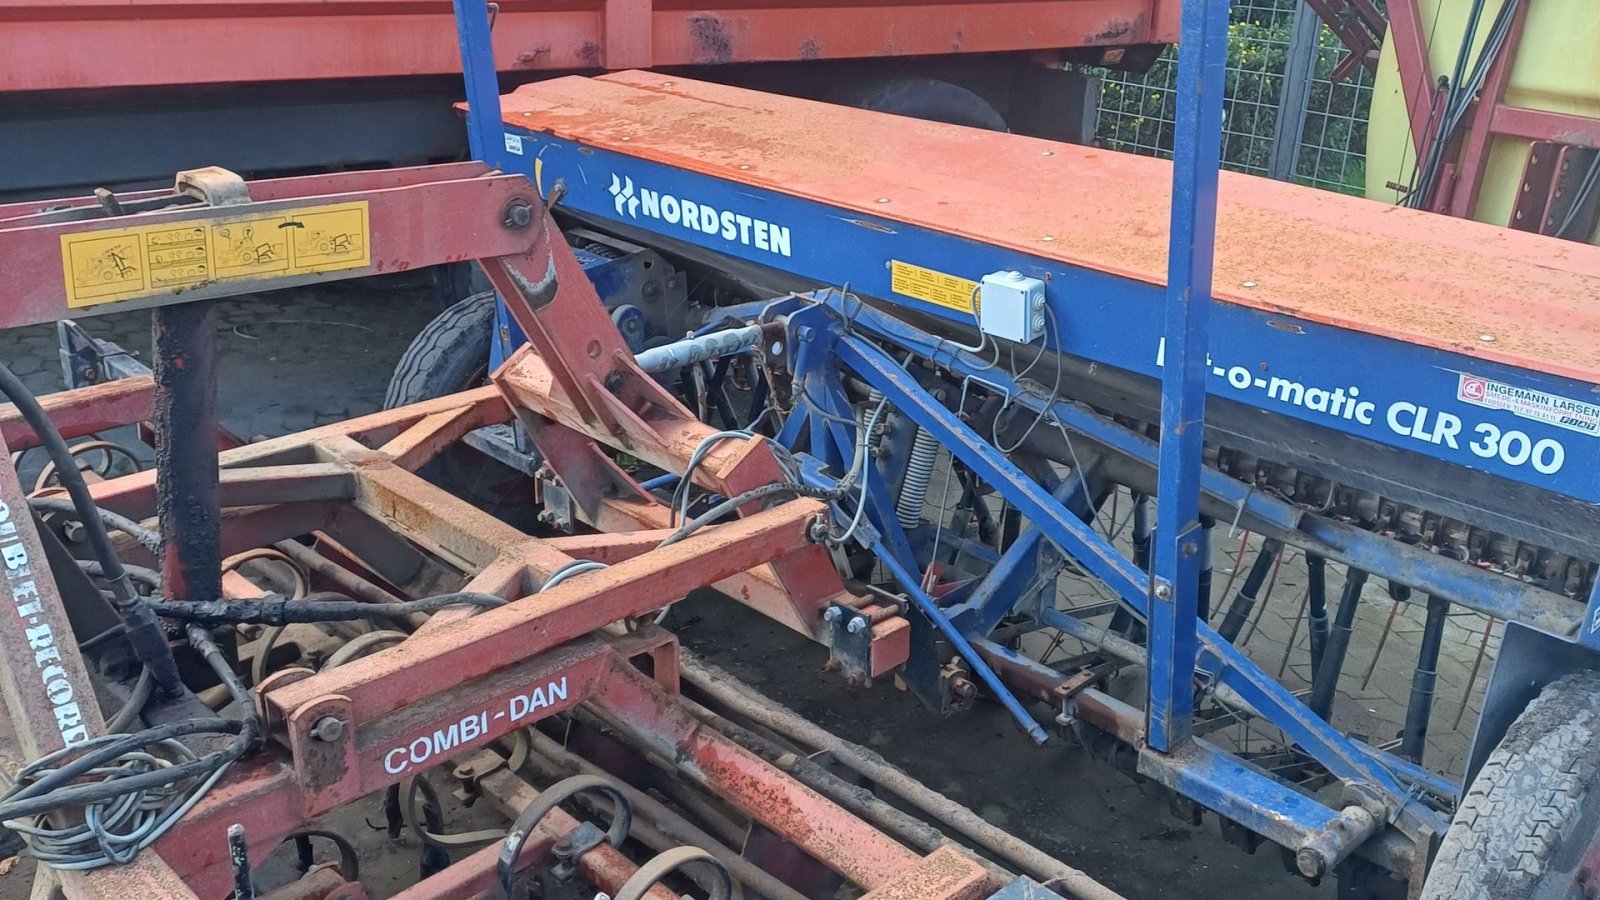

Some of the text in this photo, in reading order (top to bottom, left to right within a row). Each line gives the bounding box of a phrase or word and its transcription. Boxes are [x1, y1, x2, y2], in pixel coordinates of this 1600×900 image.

[640, 187, 792, 257] NORDSTEN
[1156, 336, 1566, 475] -o-matic CLR 300
[1486, 382, 1600, 418] INGEMANN LARSEN
[1559, 416, 1597, 431] FIAT
